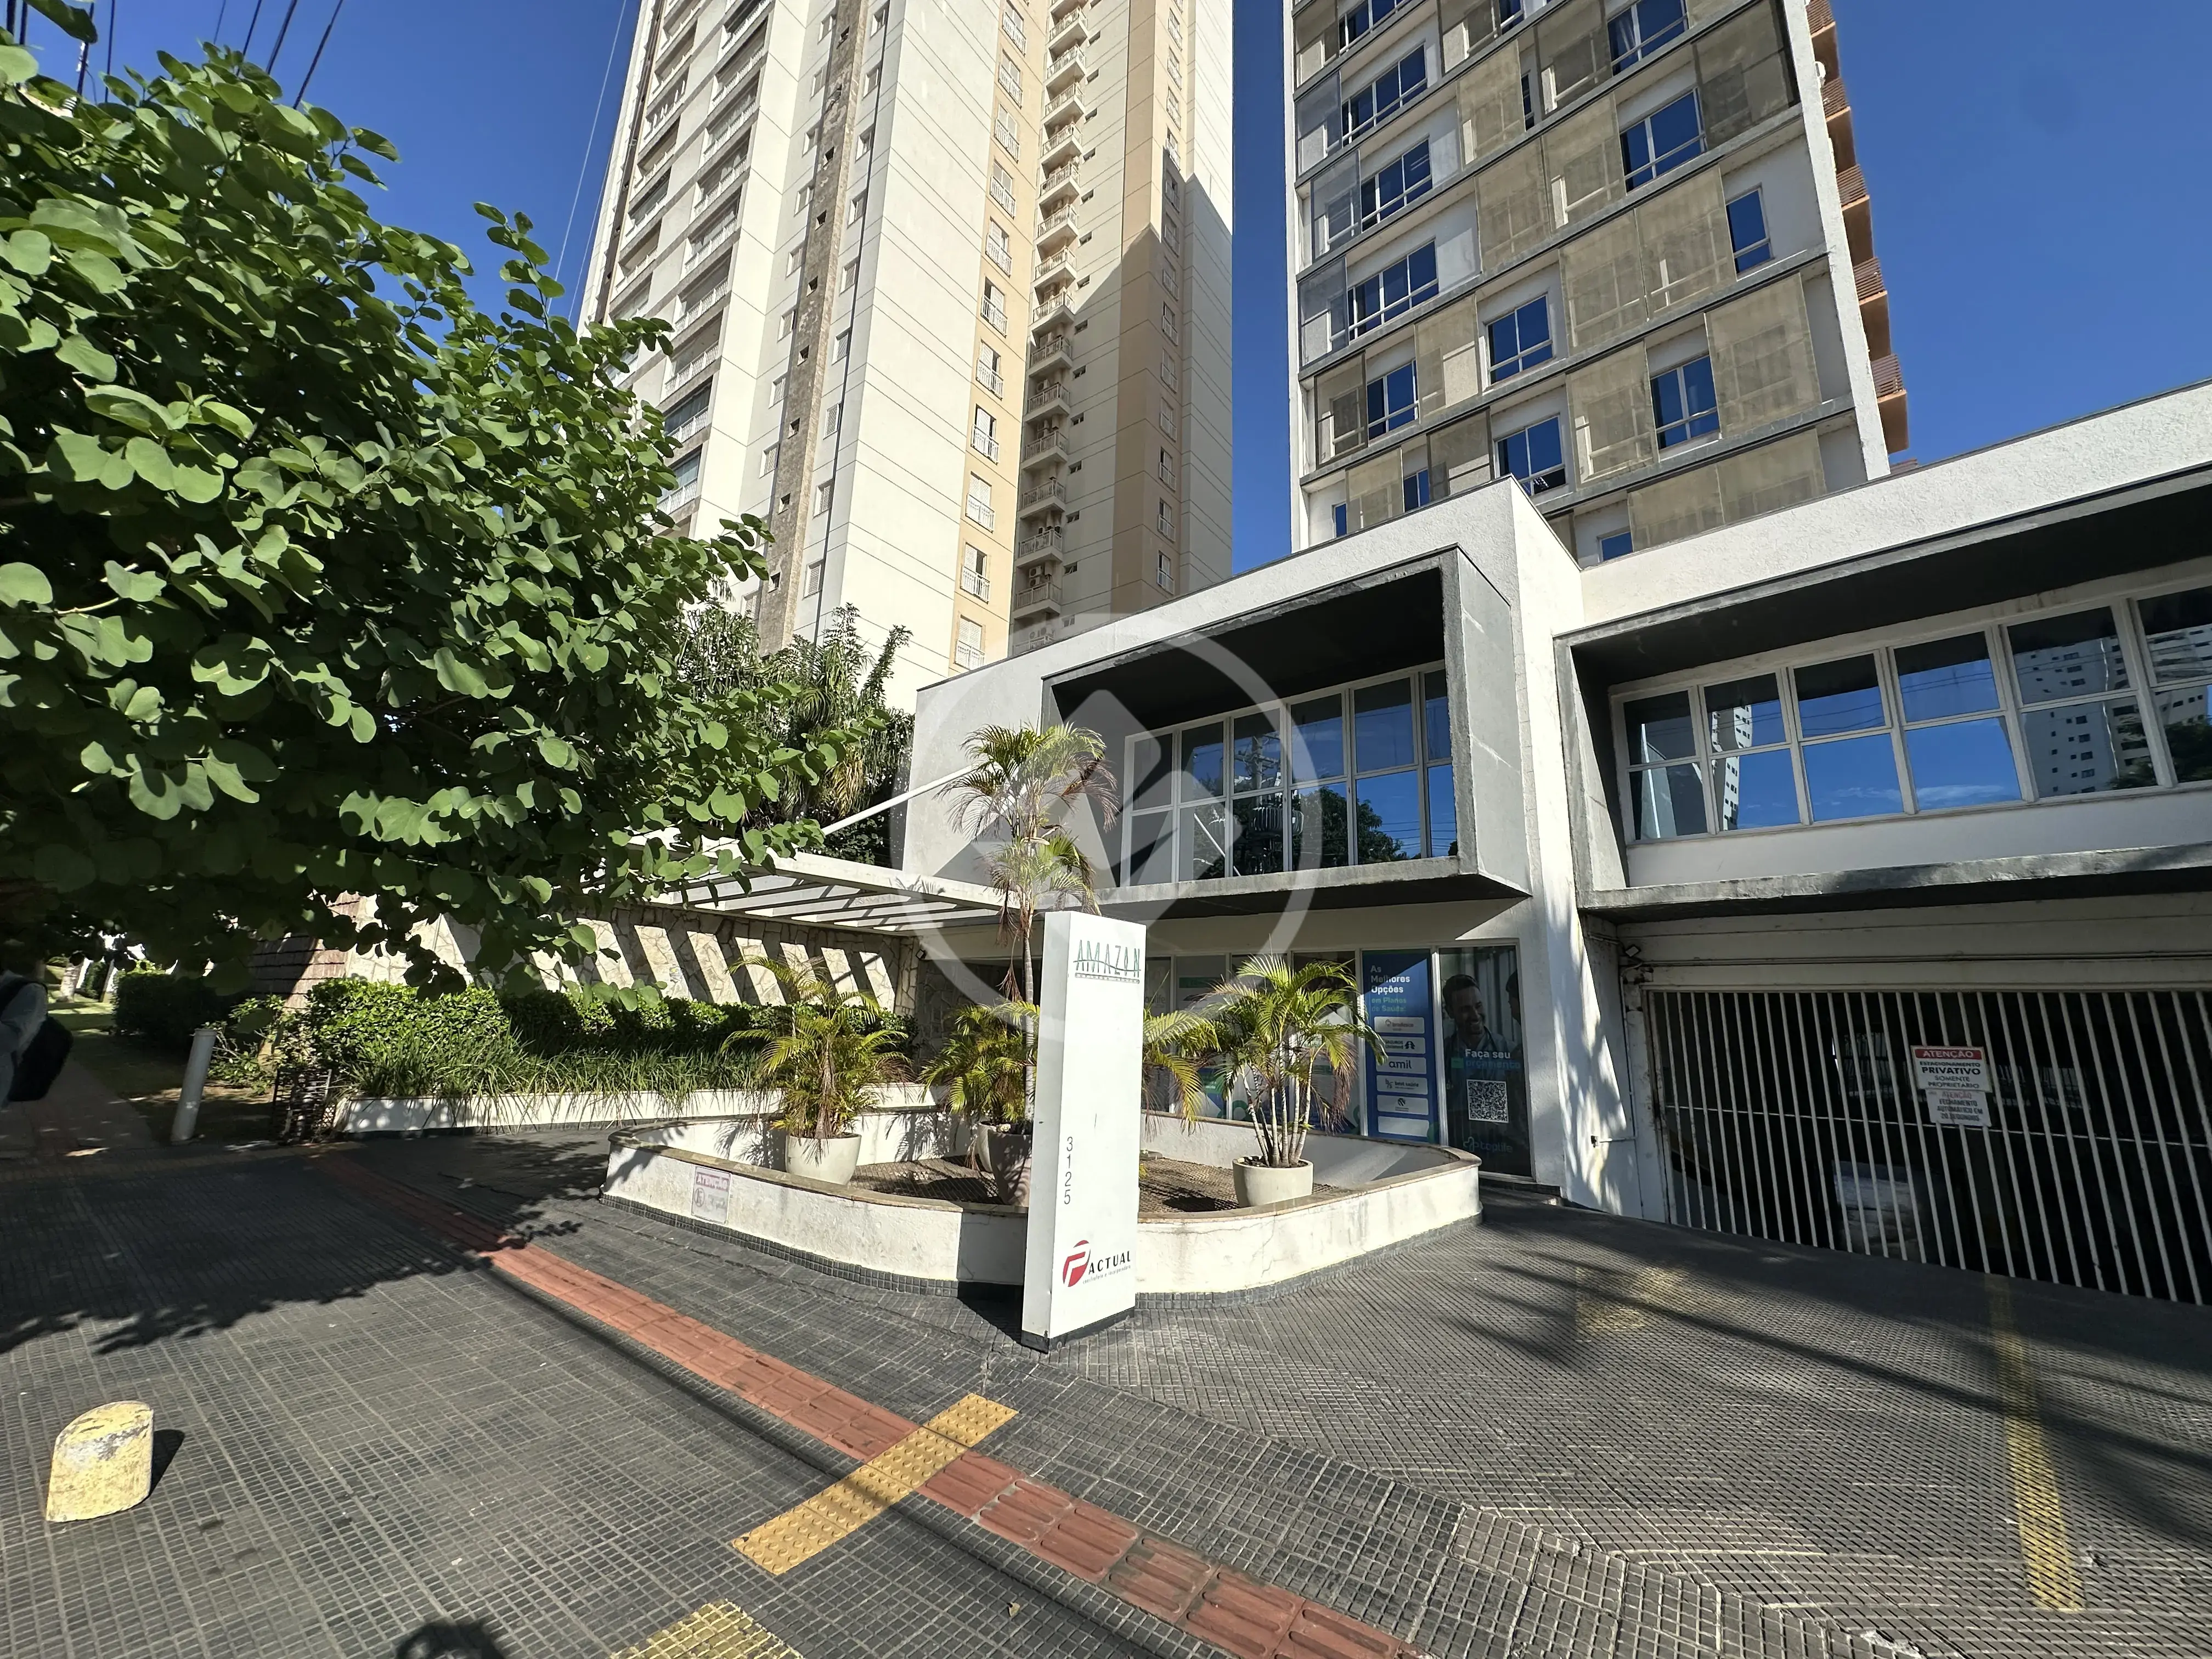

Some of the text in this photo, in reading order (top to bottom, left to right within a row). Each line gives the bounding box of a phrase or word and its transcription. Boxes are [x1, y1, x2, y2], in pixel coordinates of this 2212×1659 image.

[1075, 940, 1141, 978] AMAZON
[1372, 985, 1403, 995] Opções
[1465, 1048, 1489, 1059] Faça
[1923, 1051, 1973, 1059] ATENÇÃO
[1389, 1060, 1412, 1069] amil
[1465, 1059, 1521, 1070] orçamento
[1922, 1066, 1981, 1075] PRIVATIVO
